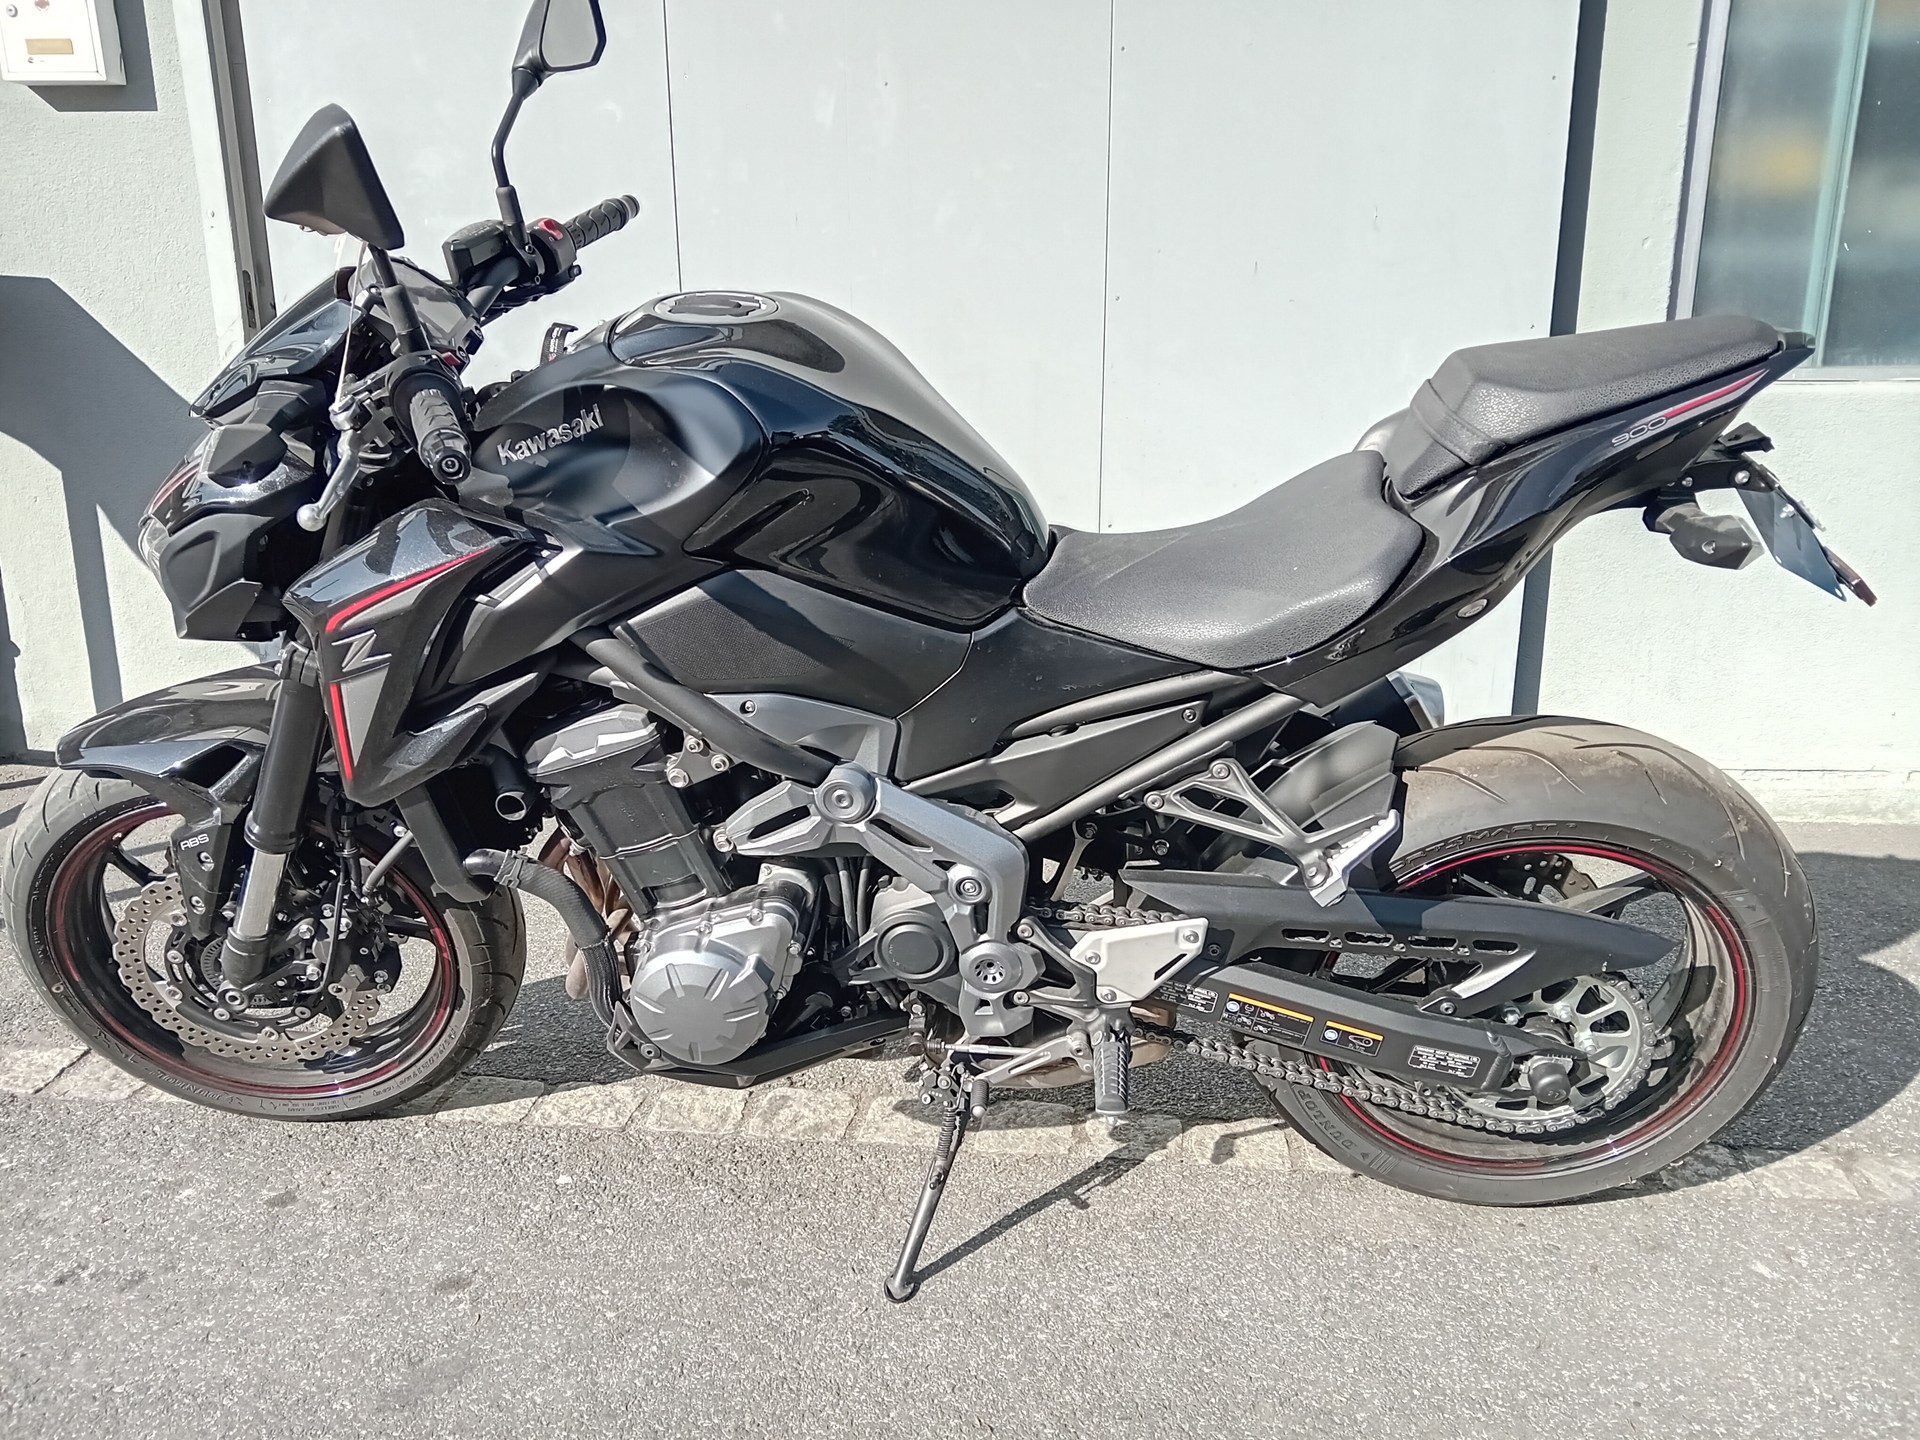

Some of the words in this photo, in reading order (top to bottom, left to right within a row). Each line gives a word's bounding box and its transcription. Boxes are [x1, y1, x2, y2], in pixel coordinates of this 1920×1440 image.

[497, 403, 605, 466] Kawasaki
[1611, 416, 1667, 447] 900
[331, 629, 393, 673] Z
[180, 833, 210, 851] ABS
[1297, 1089, 1358, 1150] DUNLOP
